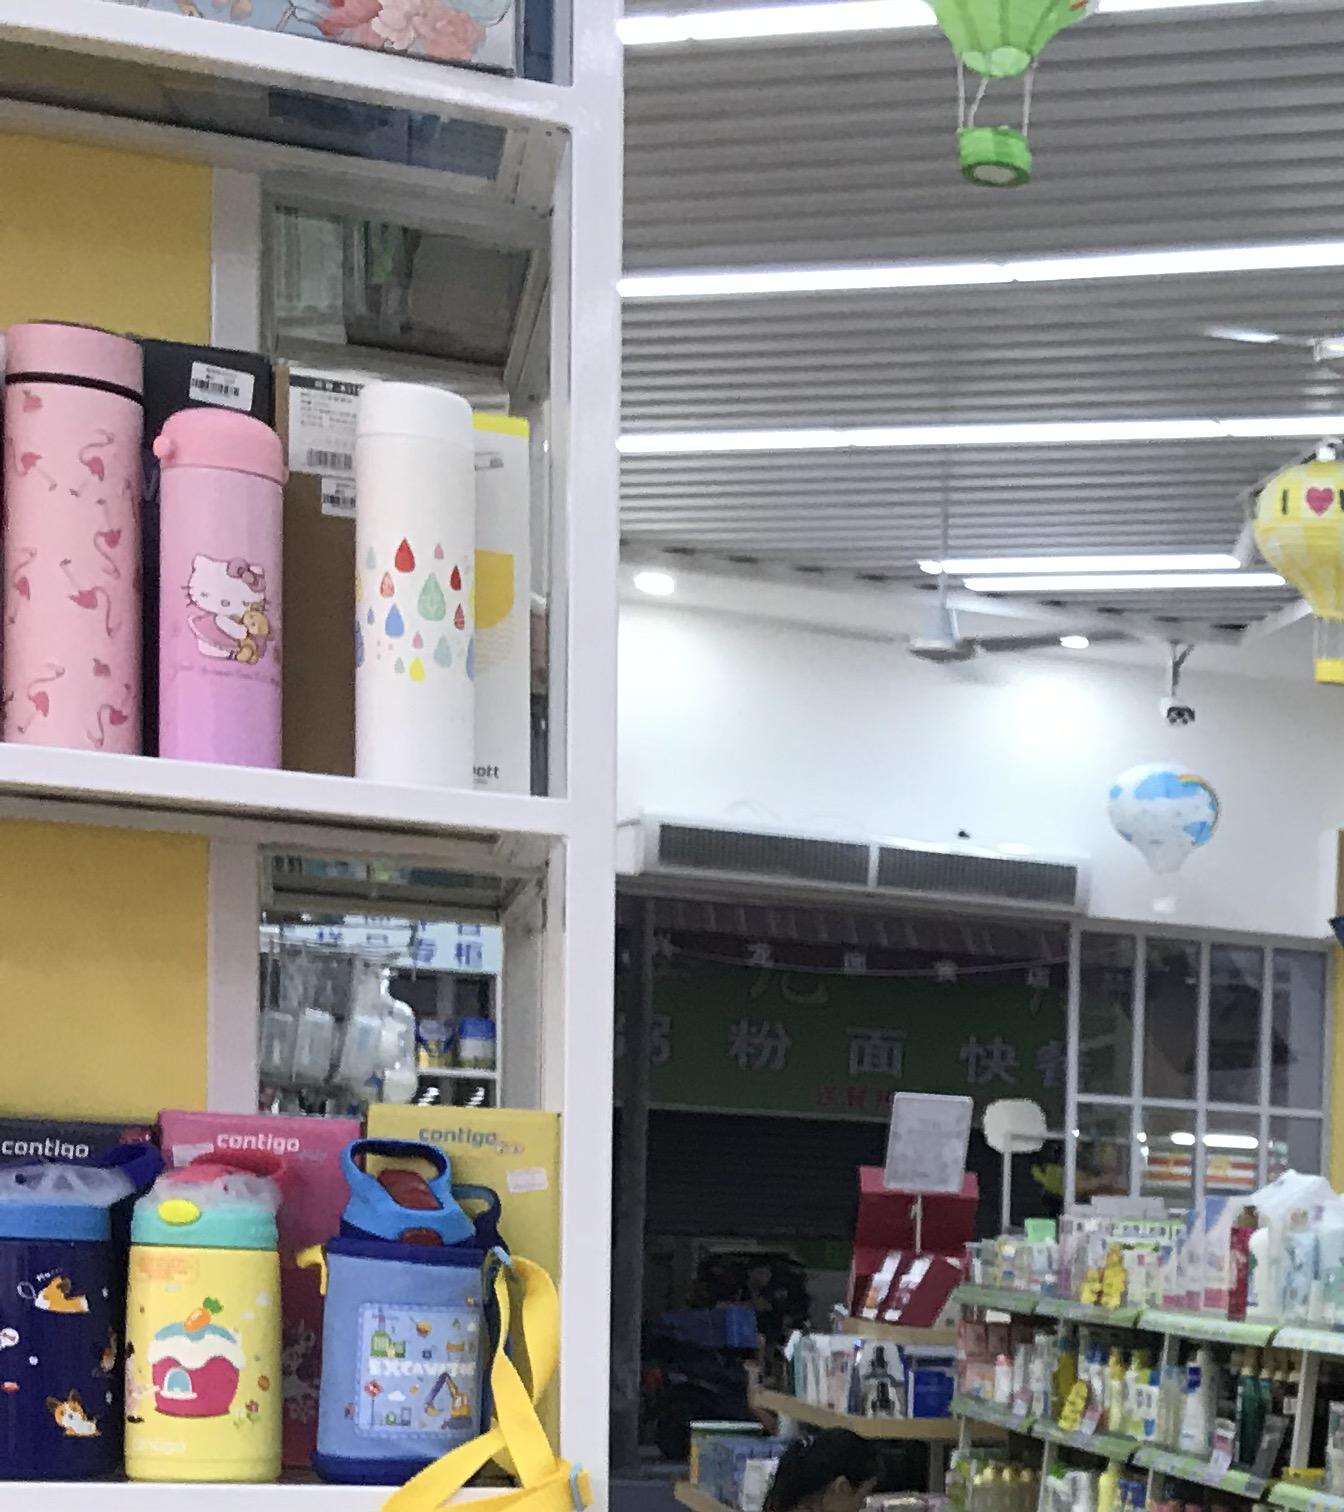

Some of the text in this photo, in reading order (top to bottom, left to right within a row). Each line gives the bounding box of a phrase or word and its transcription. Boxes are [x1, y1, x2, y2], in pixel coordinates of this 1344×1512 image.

[216, 1132, 300, 1153] contigo
[418, 1126, 497, 1147] contigo
[1, 1136, 90, 1160] contigo
